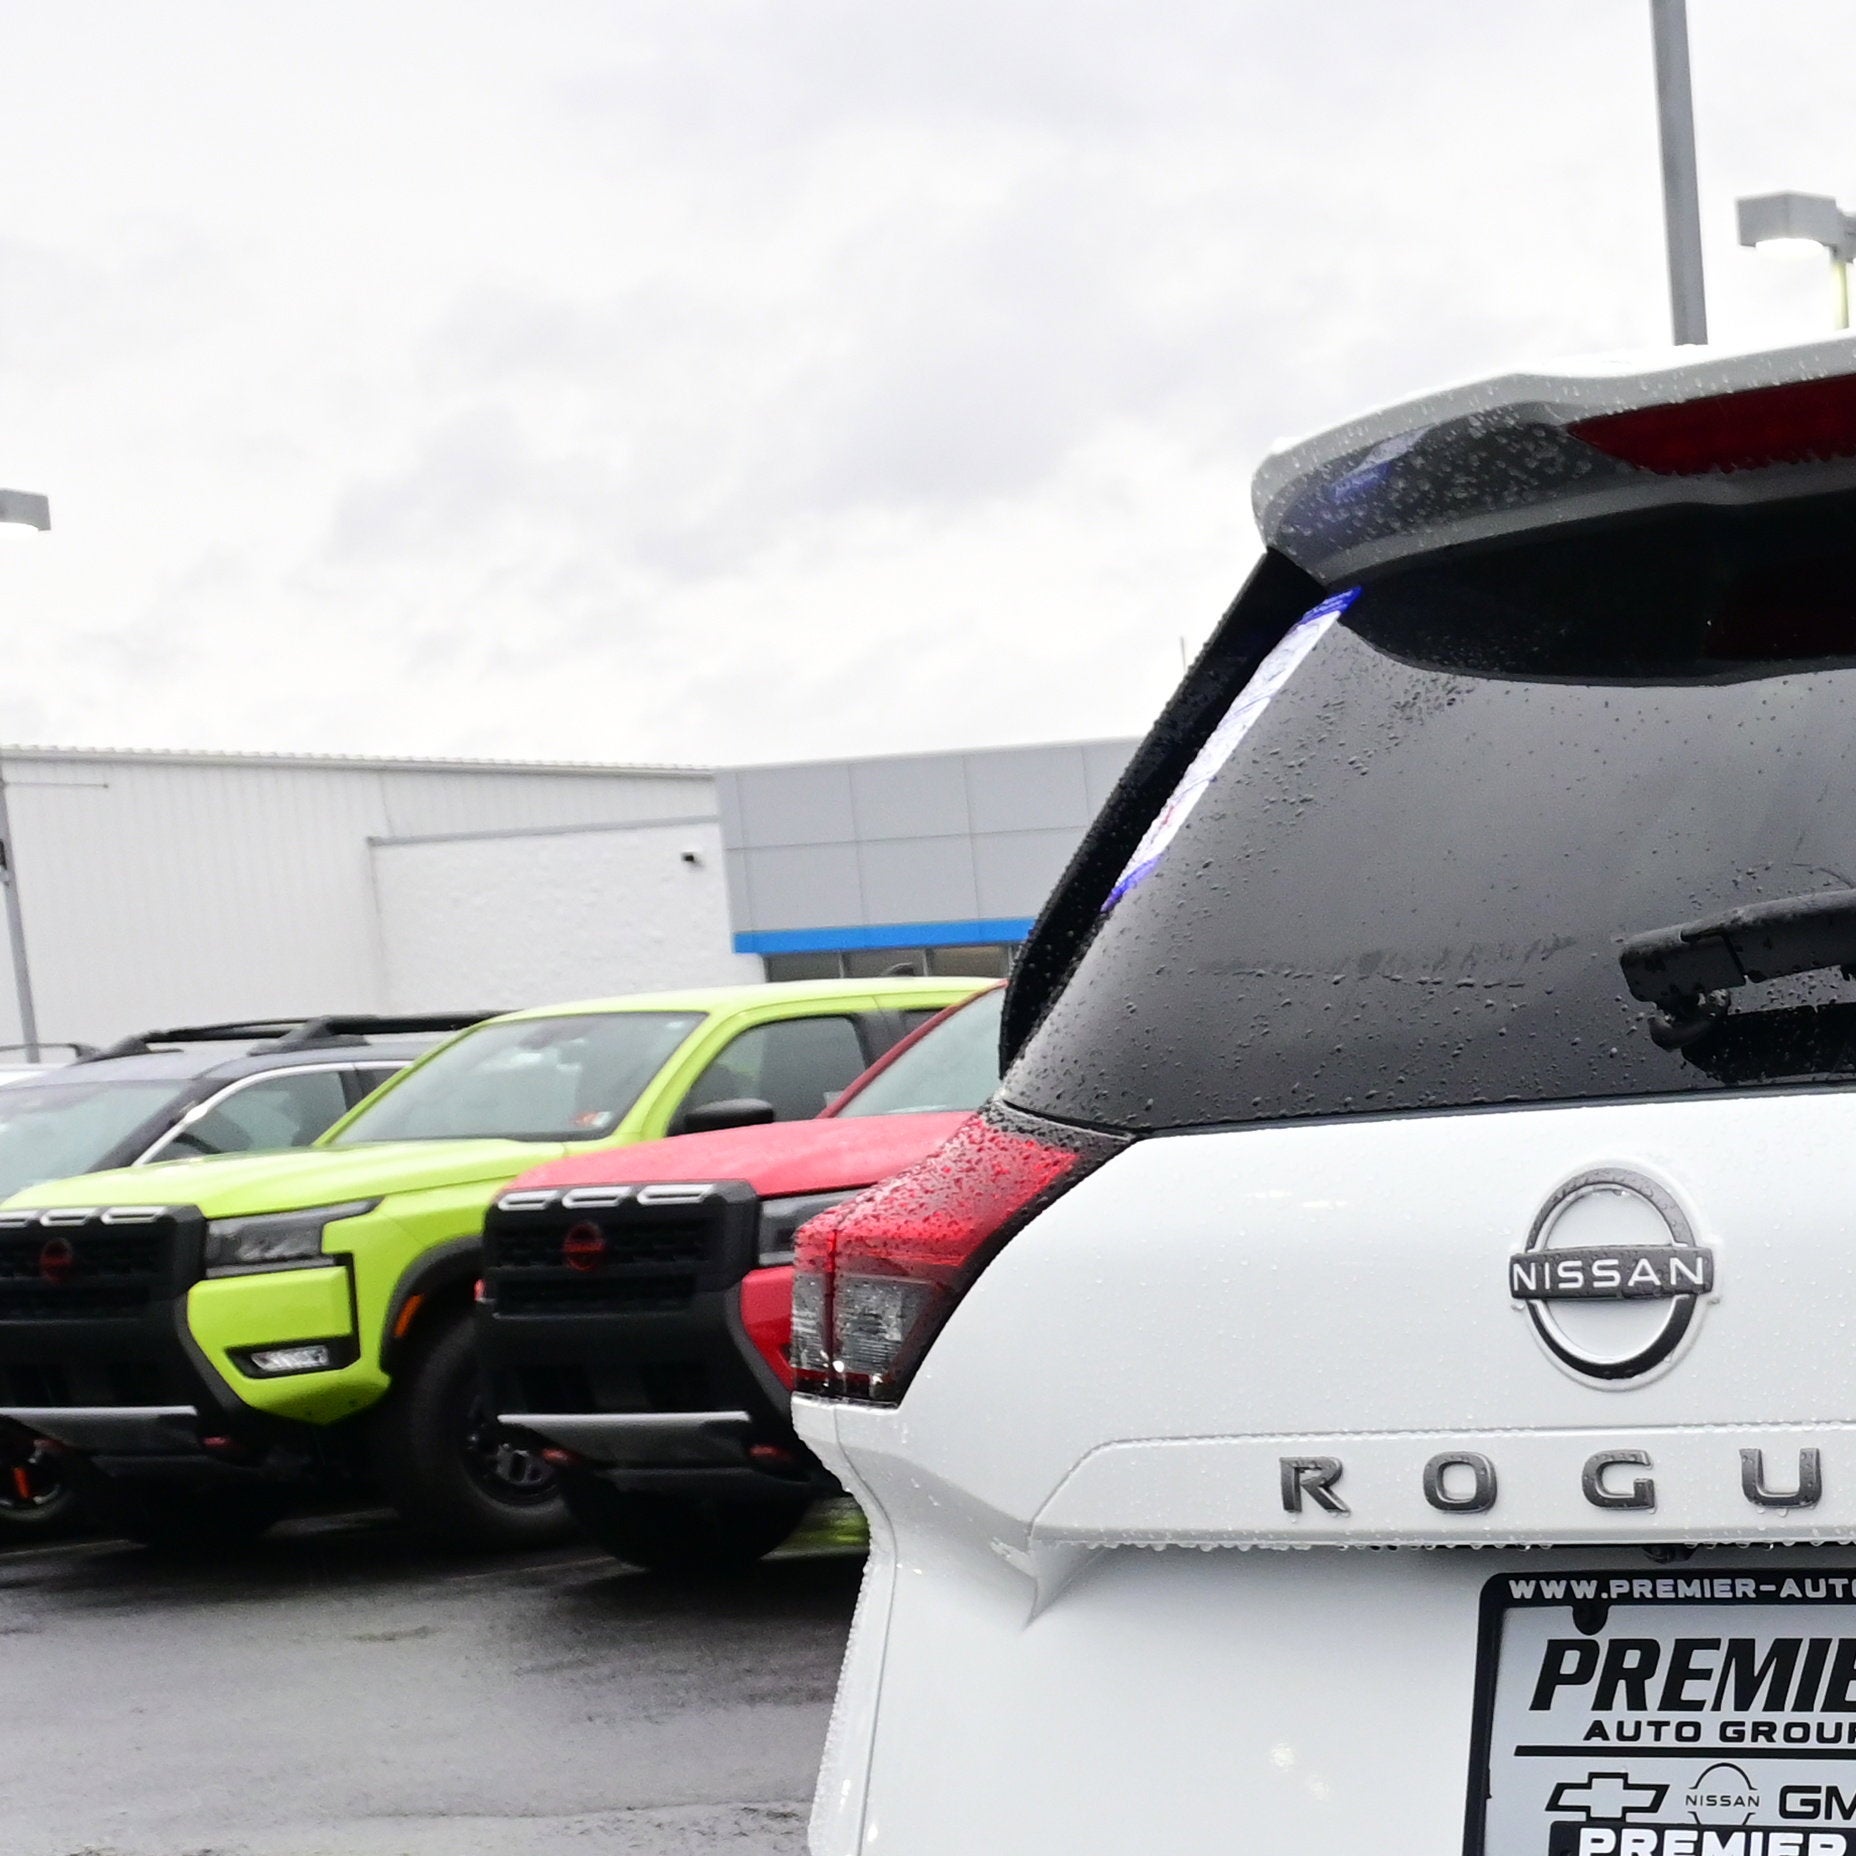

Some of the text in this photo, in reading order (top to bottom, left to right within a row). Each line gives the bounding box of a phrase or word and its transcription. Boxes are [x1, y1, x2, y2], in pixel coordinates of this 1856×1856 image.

[1512, 1257, 1705, 1291] NISSAN
[1583, 1719, 1702, 1743] AUTO
[1685, 1794, 1760, 1808] NISSAN
